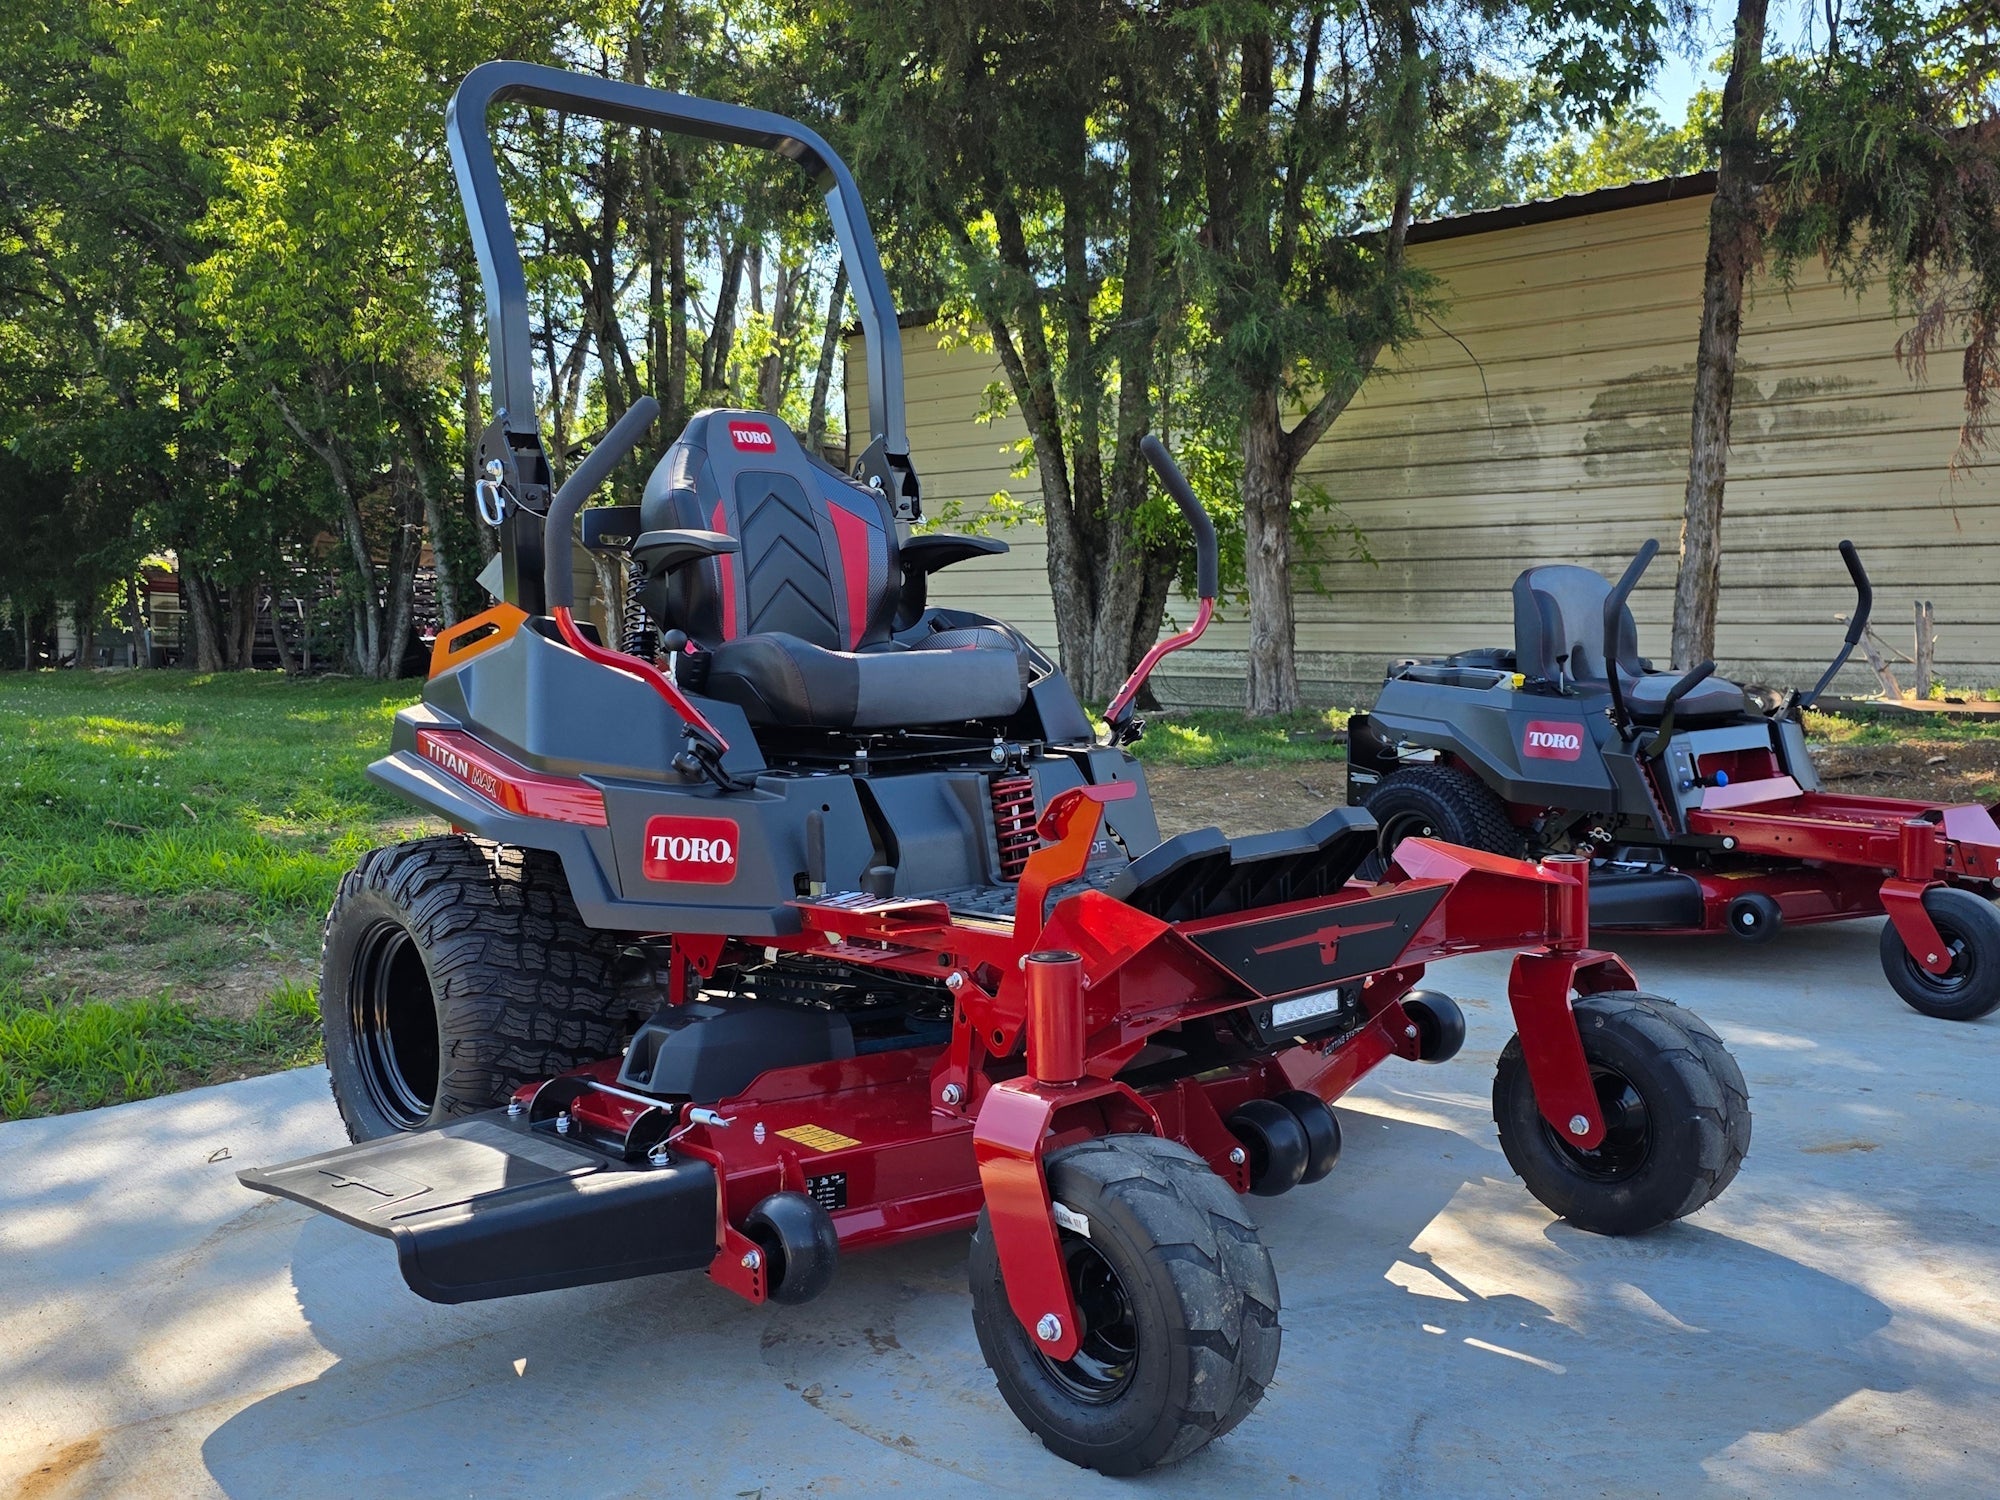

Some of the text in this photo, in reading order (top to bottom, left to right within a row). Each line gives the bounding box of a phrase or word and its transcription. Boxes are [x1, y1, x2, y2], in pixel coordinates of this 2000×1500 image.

[733, 430, 772, 445] TORO
[1529, 731, 1580, 750] TORO
[427, 740, 497, 799] TITAN MAX
[651, 835, 735, 864] TORO
